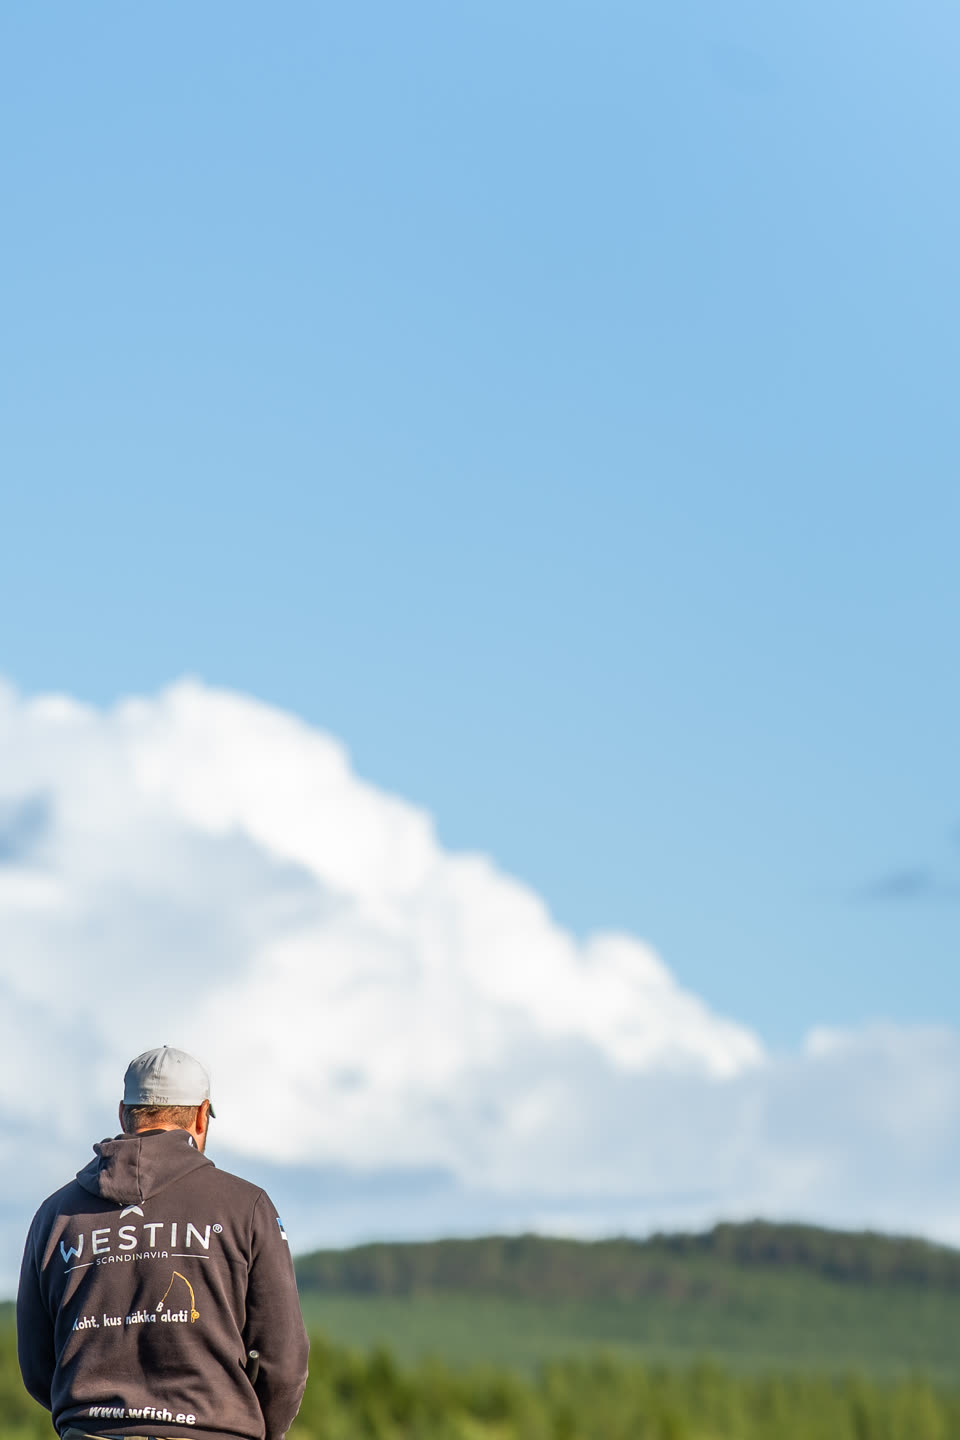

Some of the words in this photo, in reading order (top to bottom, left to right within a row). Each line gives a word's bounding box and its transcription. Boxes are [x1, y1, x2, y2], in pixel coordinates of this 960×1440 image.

[96, 1251, 169, 1266] SCANDINAVIA
[103, 1313, 122, 1326] kus
[160, 1309, 188, 1323] alati
[88, 1405, 196, 1425] www.wfish.ee
